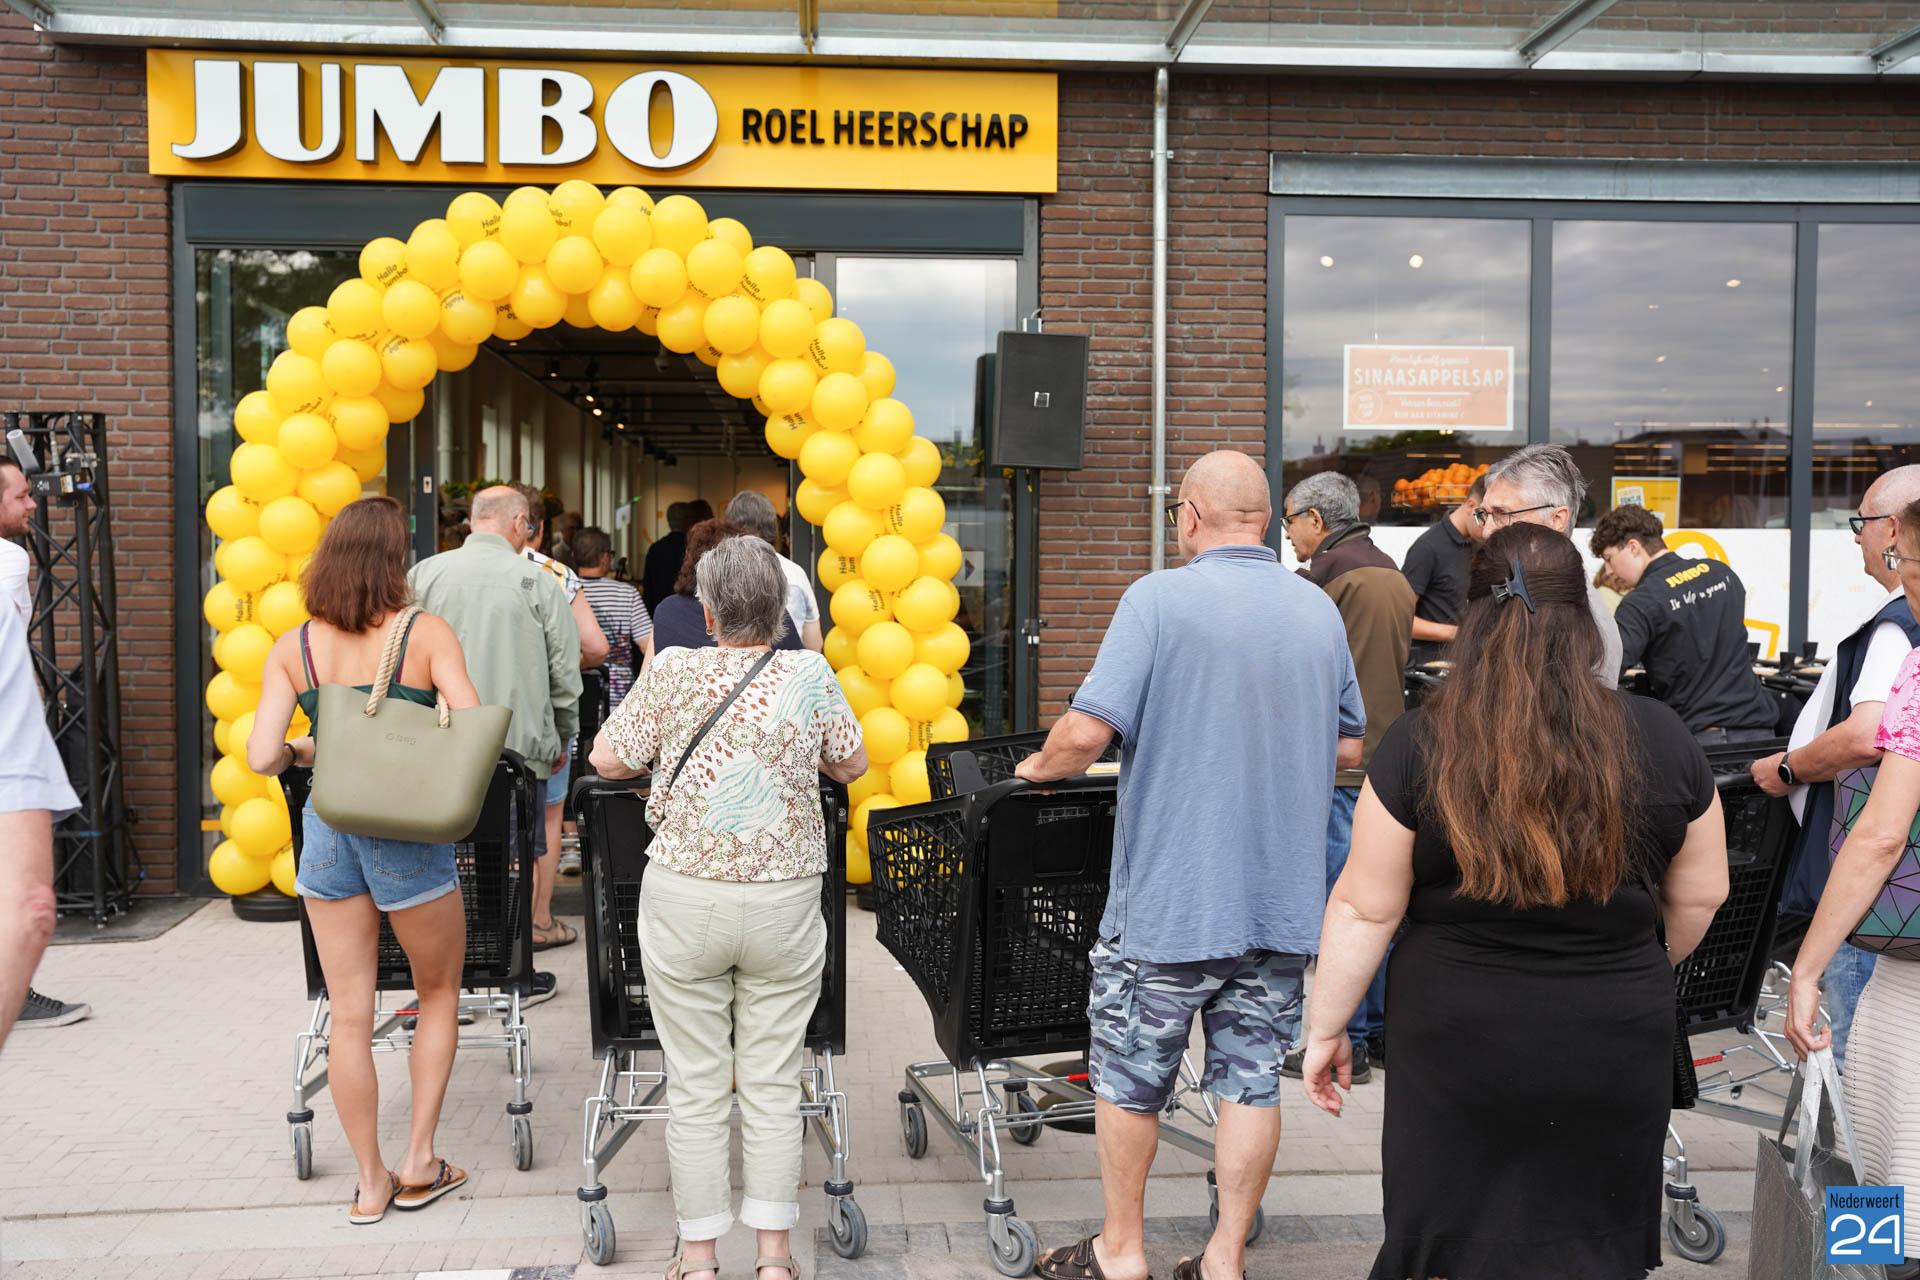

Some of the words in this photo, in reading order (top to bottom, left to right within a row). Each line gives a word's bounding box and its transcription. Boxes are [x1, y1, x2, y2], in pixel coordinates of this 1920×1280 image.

[170, 58, 719, 169] JUMBO
[742, 108, 825, 144] ROEL
[834, 110, 1028, 148] HEERSCHAP
[377, 264, 398, 281] Hallo
[743, 273, 760, 293] Hallo
[813, 338, 827, 361] Hallo
[1353, 367, 1505, 386] SINAASAPPELSAP
[838, 556, 847, 574] Hall
[848, 556, 856, 574] Jum
[1665, 563, 1710, 588] JUMBO
[235, 598, 244, 622] Hallo
